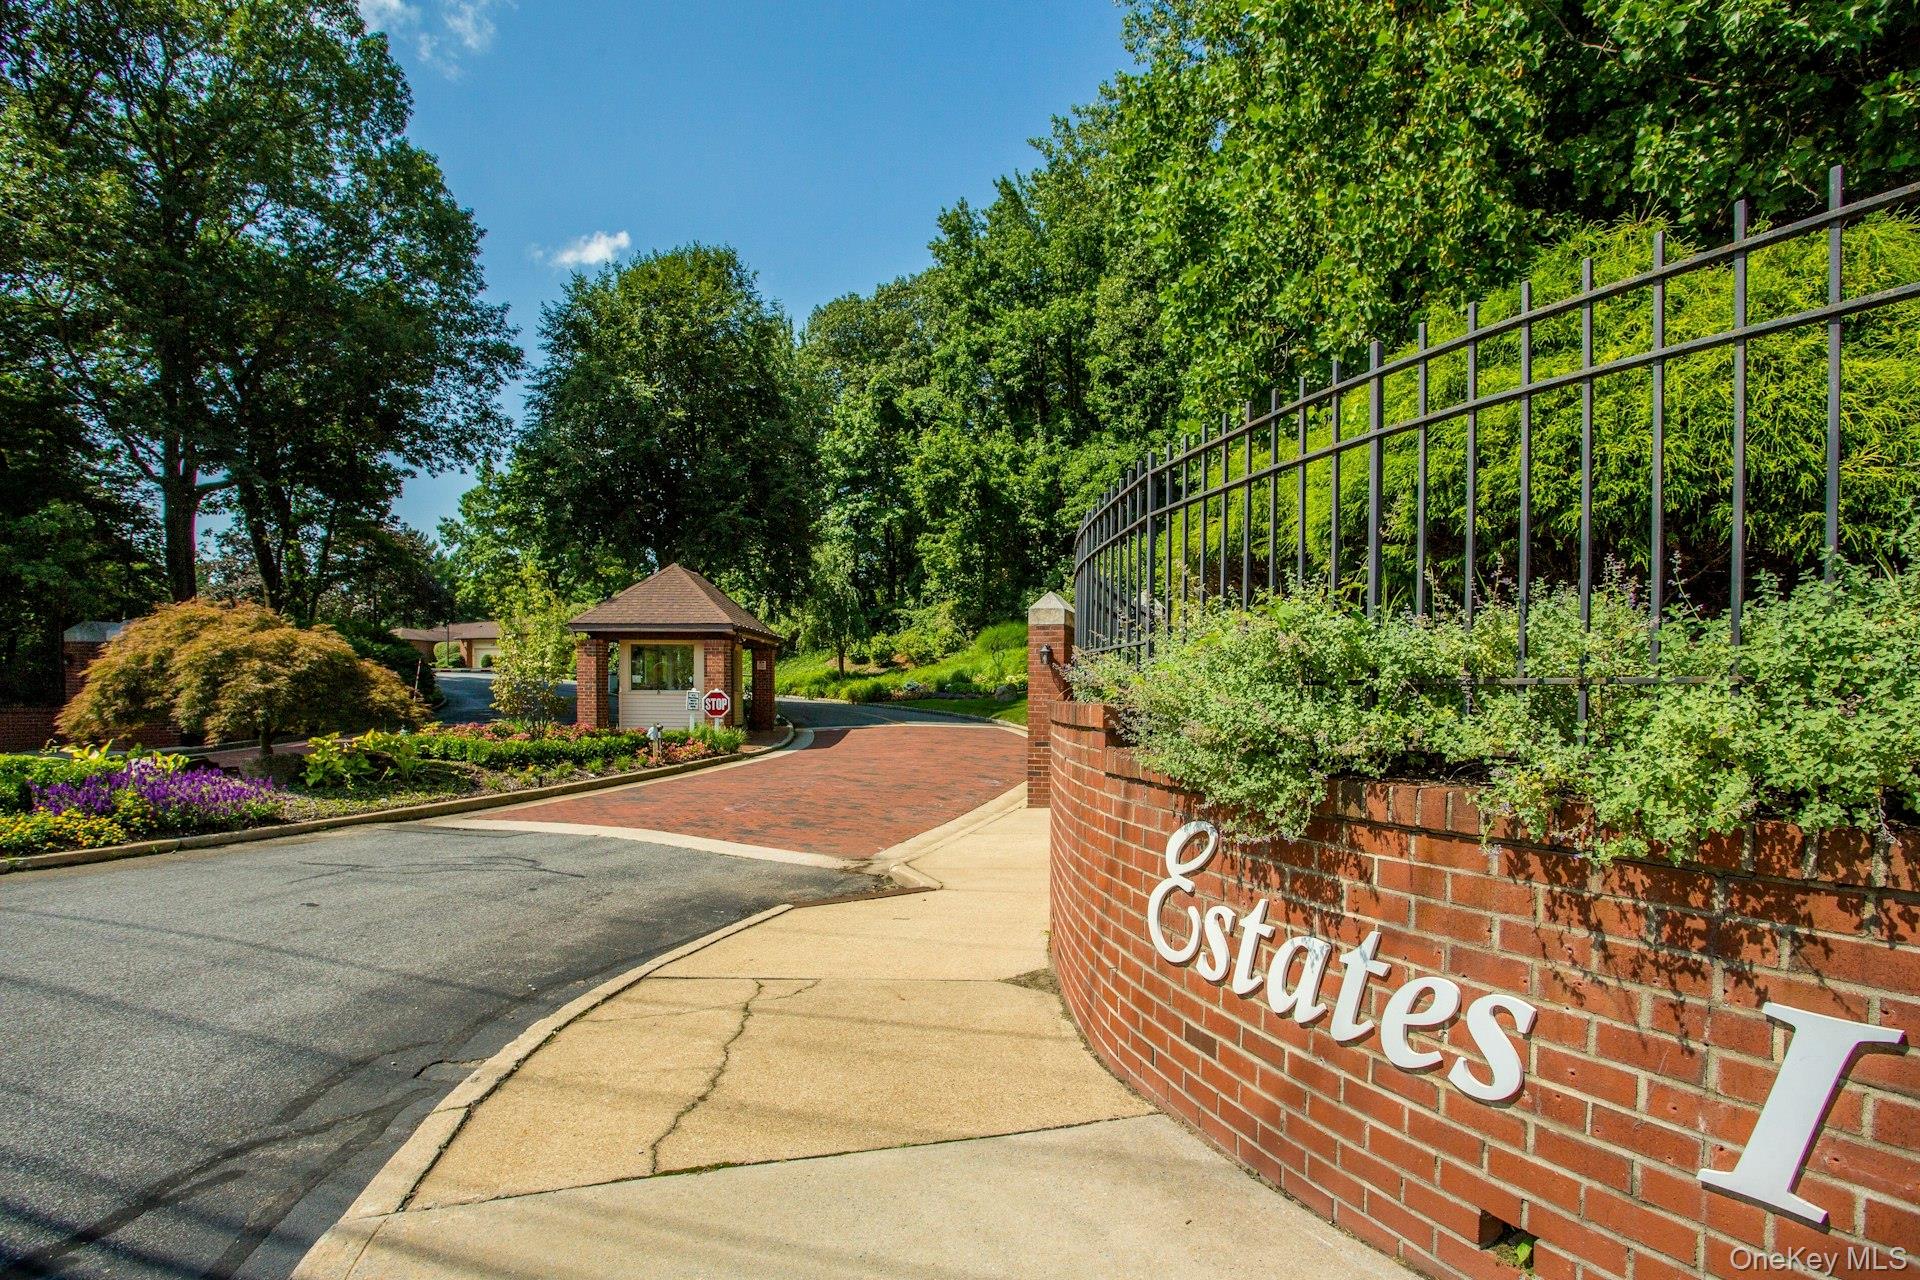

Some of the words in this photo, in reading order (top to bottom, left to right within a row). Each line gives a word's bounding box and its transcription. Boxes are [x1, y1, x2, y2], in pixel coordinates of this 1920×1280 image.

[705, 698, 727, 710] STOP
[1147, 820, 1537, 1102] Estates
[1697, 1001, 1905, 1225] I
